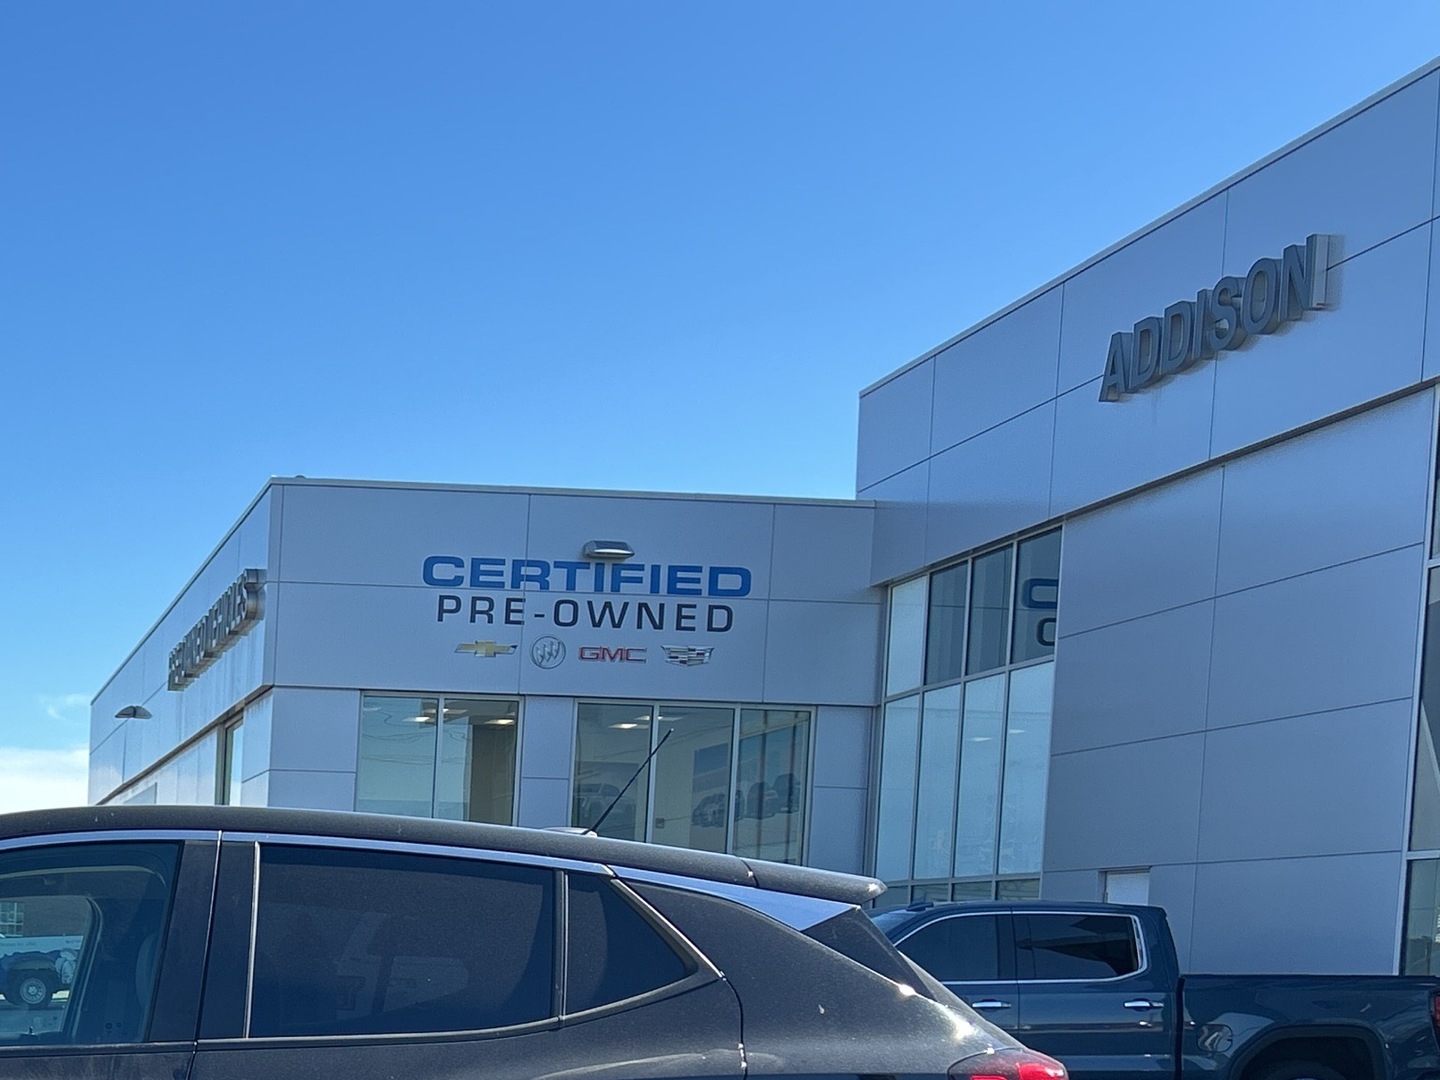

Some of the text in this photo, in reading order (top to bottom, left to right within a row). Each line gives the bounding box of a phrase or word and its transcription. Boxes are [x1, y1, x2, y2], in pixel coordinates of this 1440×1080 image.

[1099, 233, 1331, 402] ADDISON
[422, 555, 752, 597] CERTIFIED
[437, 594, 734, 633] PRE-OWNED
[578, 645, 647, 663] GMC
